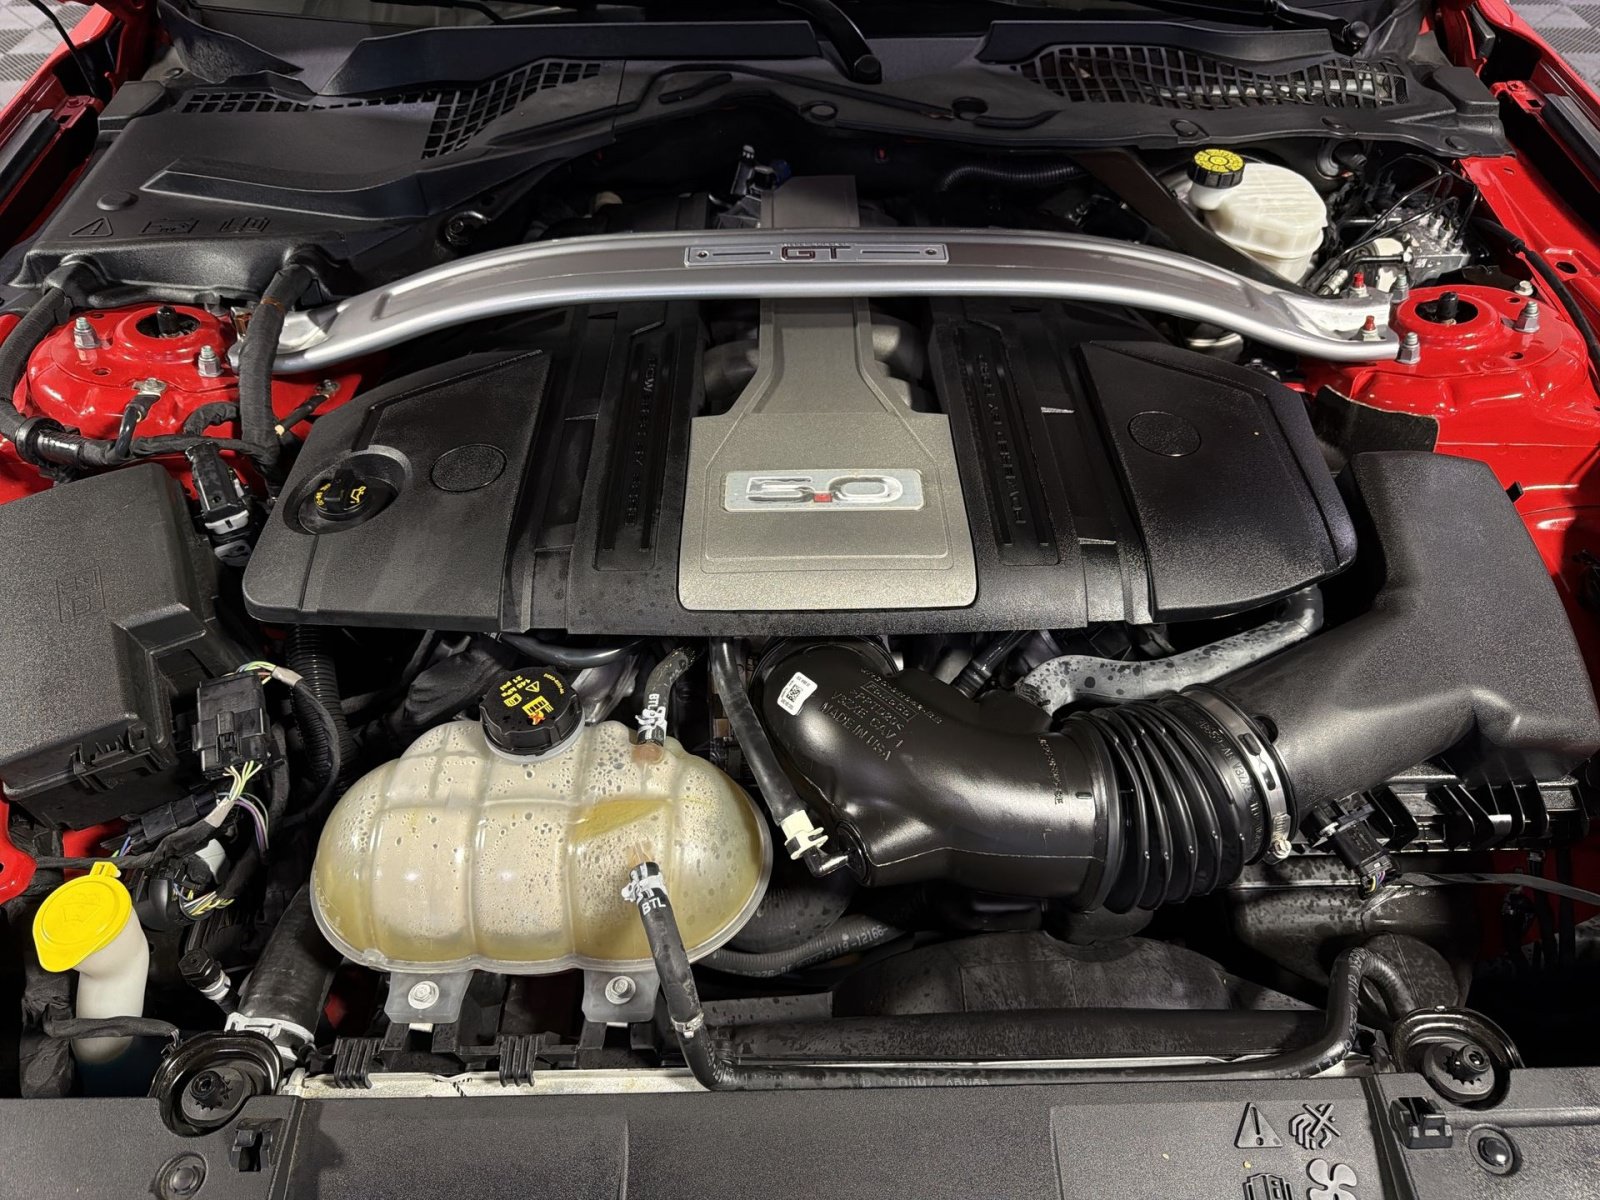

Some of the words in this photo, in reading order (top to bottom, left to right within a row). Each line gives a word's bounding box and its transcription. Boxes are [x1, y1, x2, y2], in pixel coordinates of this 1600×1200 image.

[781, 245, 851, 261] GT
[746, 474, 904, 504] 5.0
[819, 702, 856, 729] MADE
[852, 724, 869, 739] IN
[866, 735, 891, 761] USA
[869, 717, 897, 740] CAV
[641, 897, 667, 916] BTL
